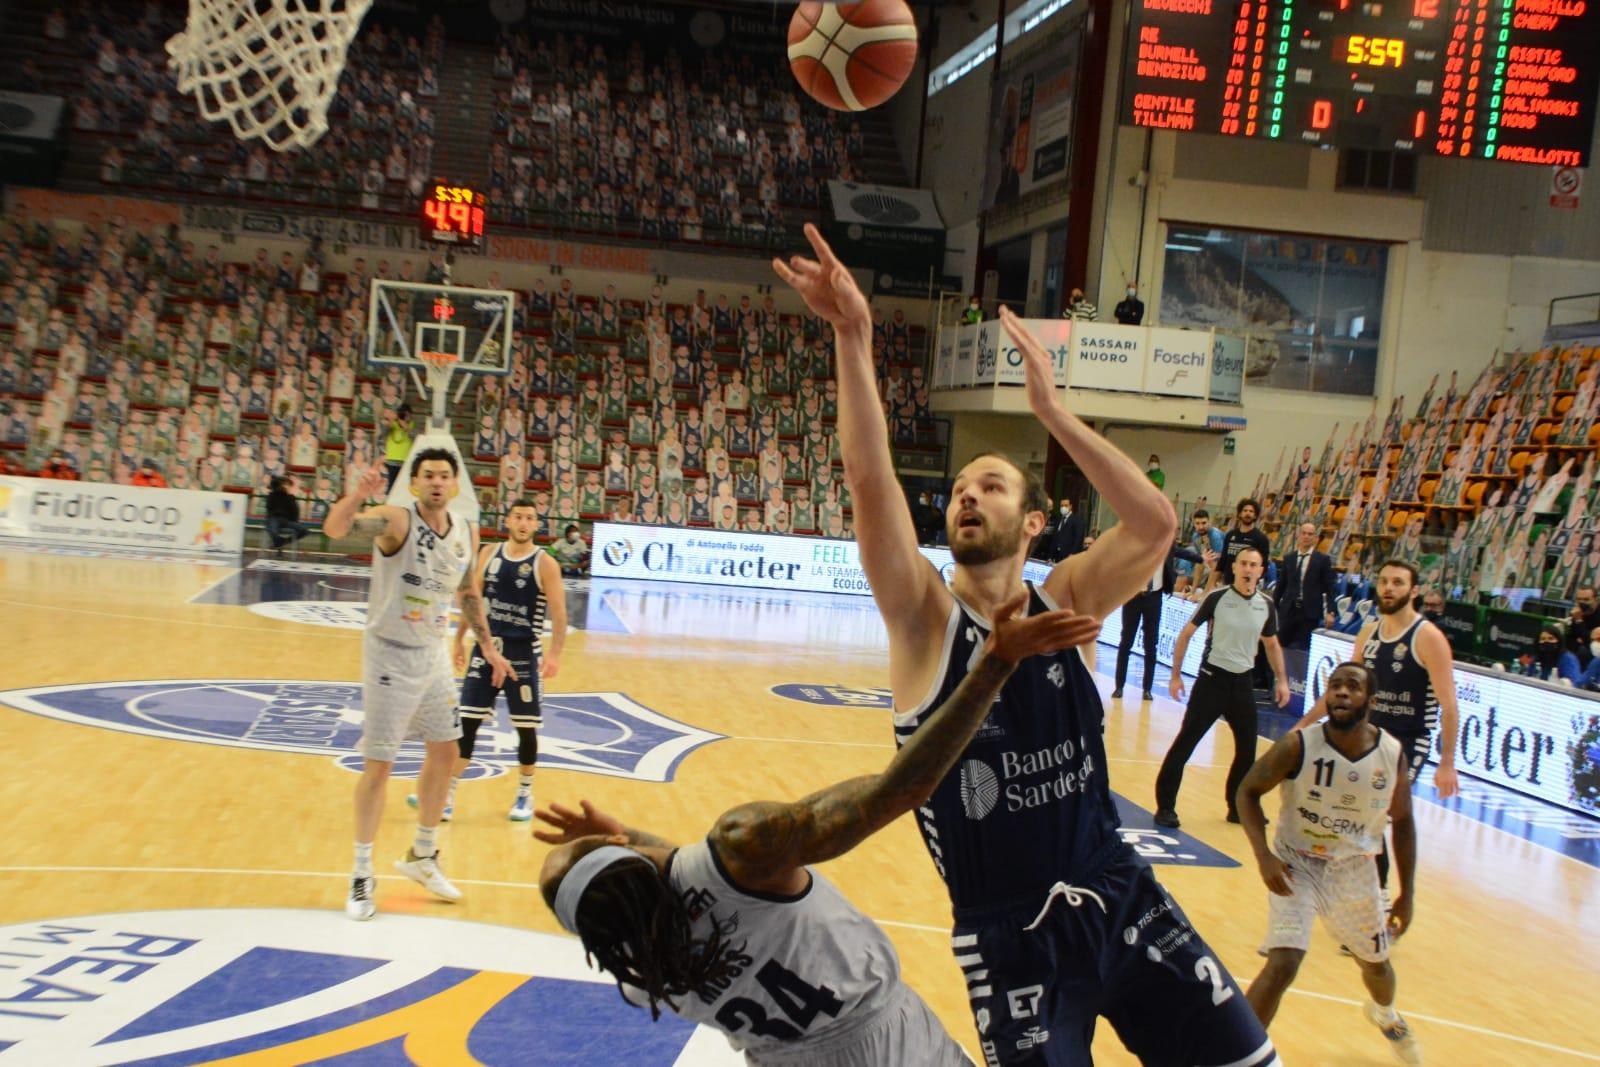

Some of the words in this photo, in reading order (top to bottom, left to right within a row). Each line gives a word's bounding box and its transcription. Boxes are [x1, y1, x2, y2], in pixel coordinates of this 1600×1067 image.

[1283, 7, 1292, 21] 0
[1281, 24, 1291, 39] 0
[1499, 28, 1509, 43] 0
[1279, 41, 1289, 55] 0
[1347, 35, 1405, 68] 5:59
[1497, 45, 1507, 60] 0
[1277, 57, 1287, 72] 0
[1494, 61, 1505, 75] 2
[1275, 74, 1286, 88] 2
[1492, 79, 1503, 93] 2
[1273, 91, 1284, 105] 0
[1490, 95, 1501, 109] 0
[1134, 93, 1196, 113] GENTILE
[1272, 107, 1283, 121] 0
[1312, 100, 1332, 129] 0
[1270, 124, 1281, 138] 0
[1486, 128, 1498, 142] 0
[1484, 143, 1496, 158] 0
[1080, 337, 1137, 351] SASSARI
[1080, 351, 1128, 364] NUORO
[1153, 348, 1206, 367] Foschi
[31, 490, 181, 530] FidiCoop
[642, 541, 801, 582] Character
[813, 544, 848, 565] FEEL
[1000, 738, 1076, 781] Banco
[1312, 757, 1336, 788] 11
